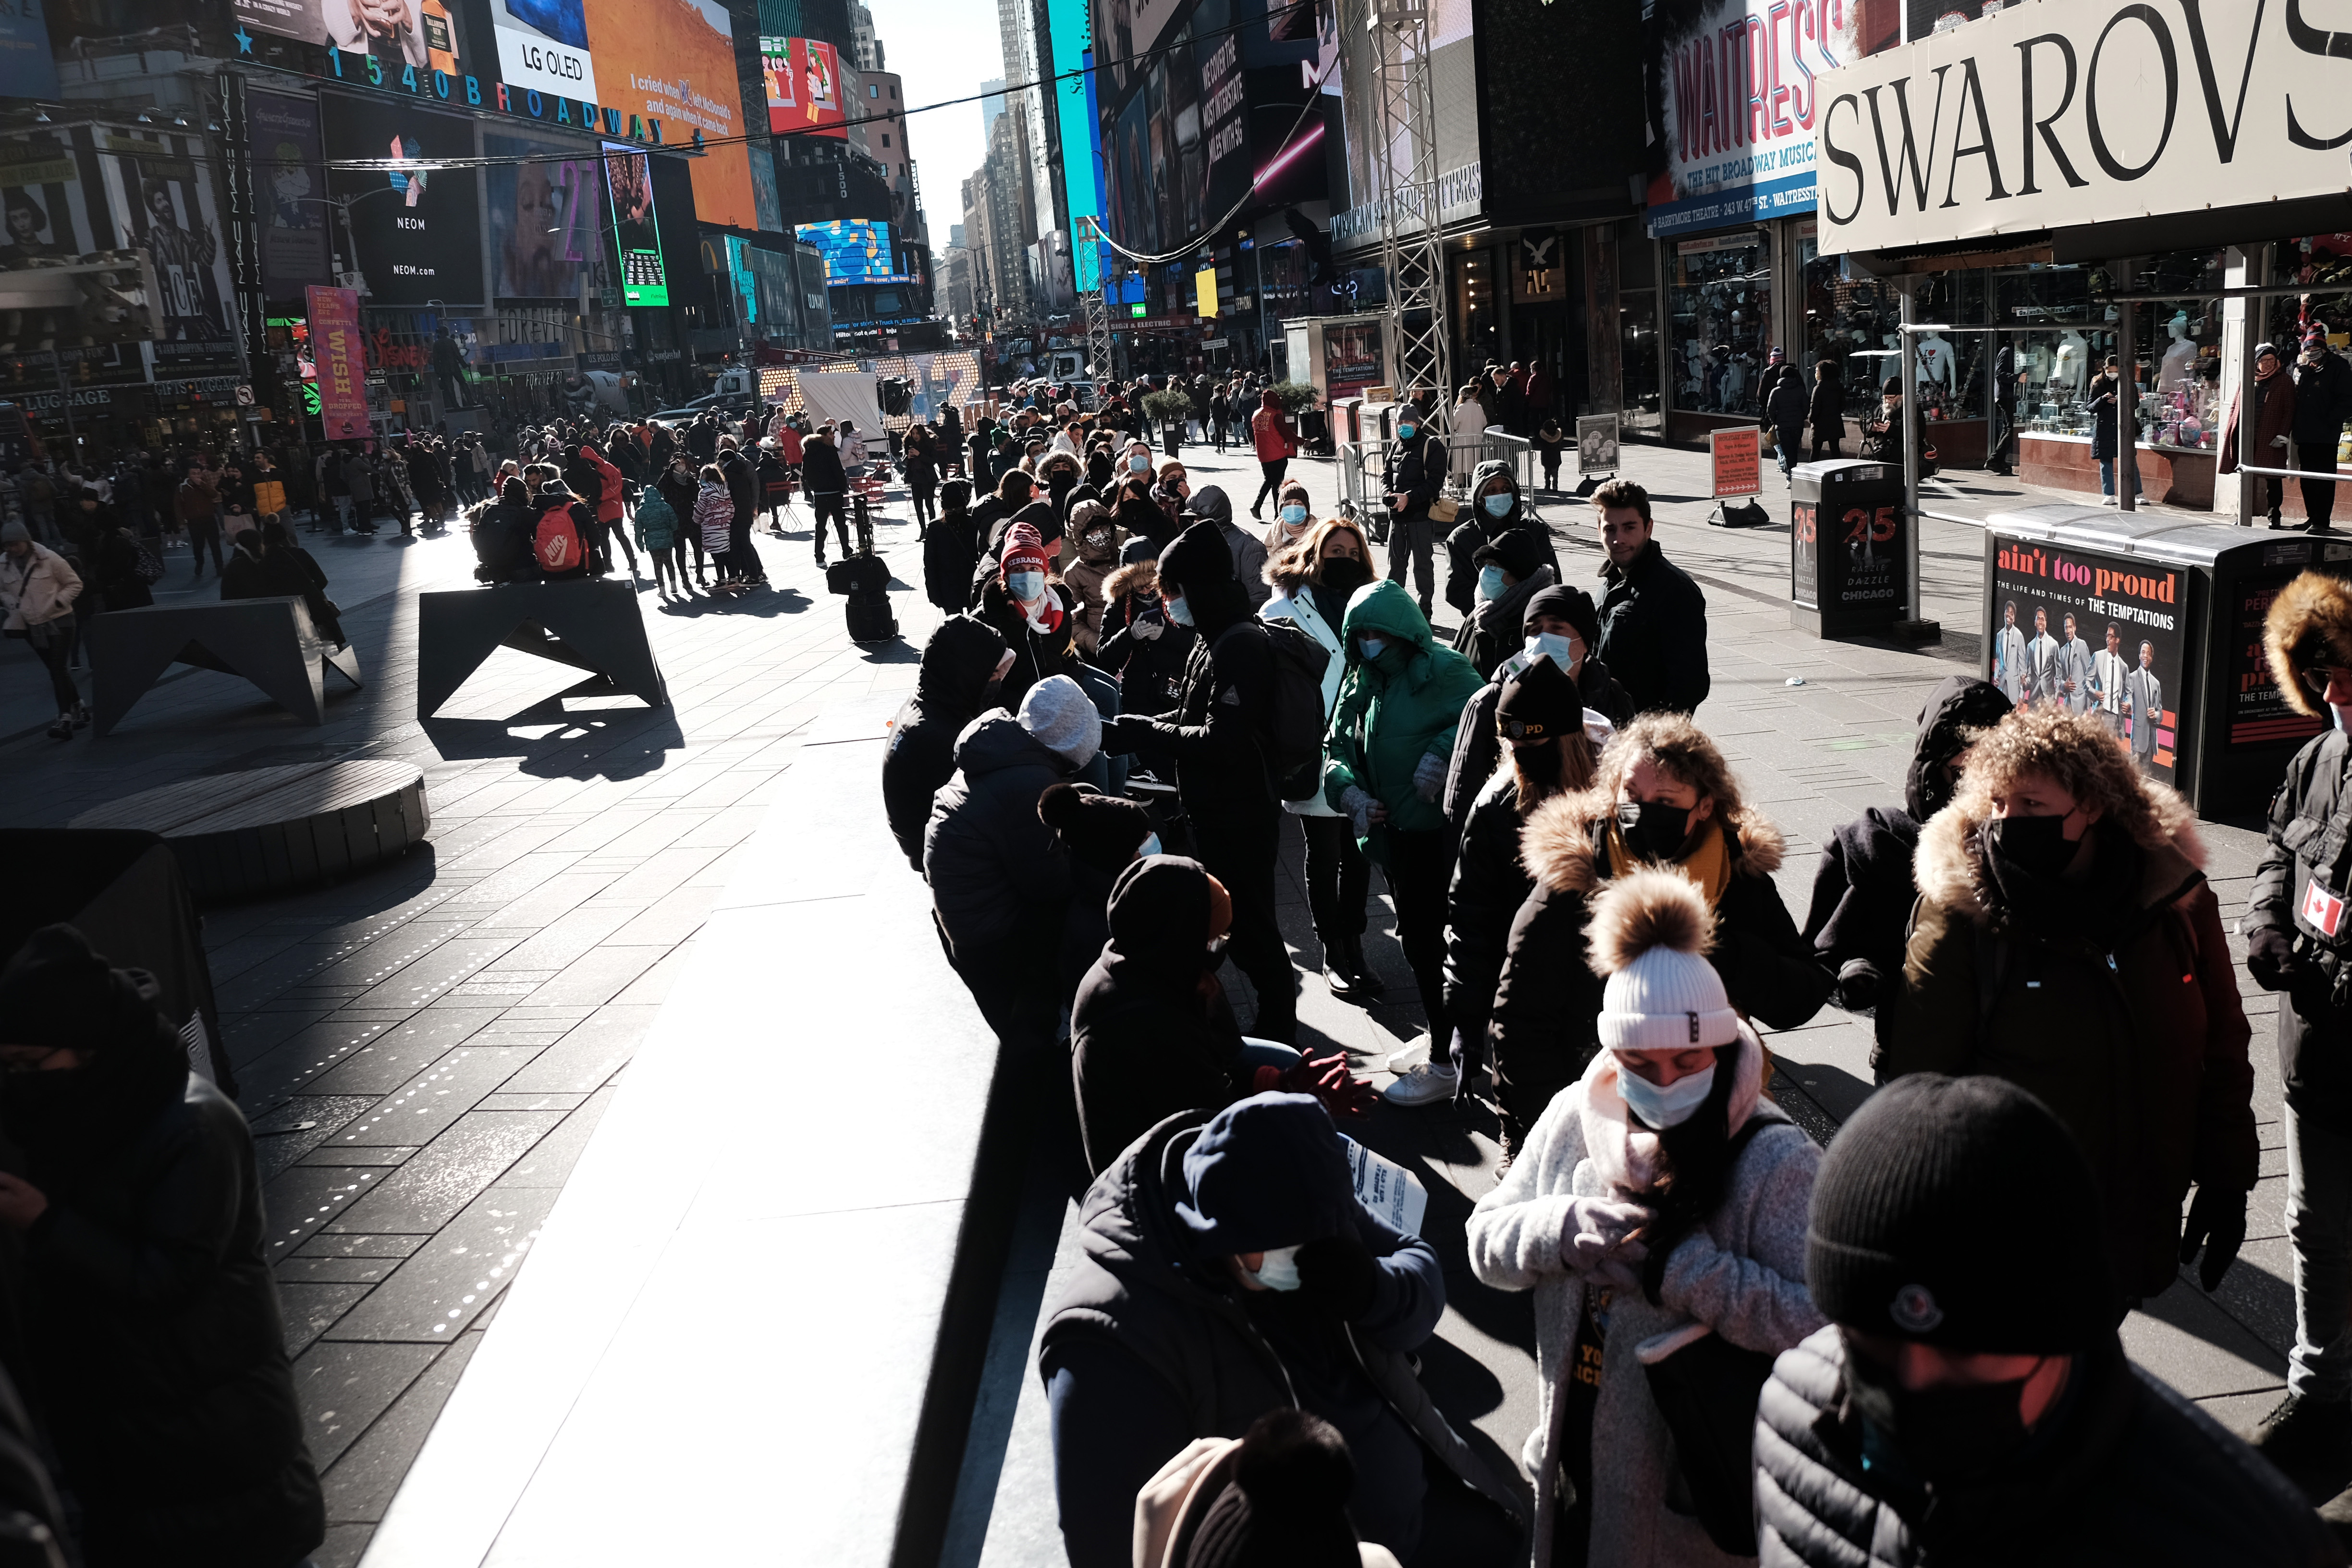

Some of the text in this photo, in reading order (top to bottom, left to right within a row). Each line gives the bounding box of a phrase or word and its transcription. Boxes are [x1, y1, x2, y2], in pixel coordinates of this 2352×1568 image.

[522, 44, 583, 81] LG OLED
[1202, 34, 1236, 91] WE COVER THE
[840, 66, 858, 95] CONNECT
[1672, 0, 1842, 162] WAITRESS
[638, 75, 663, 94] cried
[663, 81, 680, 100] when
[692, 92, 703, 109] left
[703, 97, 731, 120] McDonald's
[1202, 72, 1243, 131] MOST INTERSTATE
[647, 98, 729, 136] and again when it came back
[1208, 116, 1243, 165] MILES WITH 5G
[838, 163, 847, 198] 1500
[1687, 170, 1703, 189] THE
[1705, 165, 1720, 185] HIT
[1723, 152, 1776, 181] BROADWAY
[397, 218, 426, 231] NEOM
[1330, 201, 1372, 242] AMERICAN
[1658, 210, 1691, 229] BARRYMORE
[1692, 205, 1718, 221] THEATRE
[1724, 202, 1735, 215] 243
[393, 265, 435, 276] NEOM.com
[1235, 295, 1252, 311] SEPHORA
[498, 308, 570, 344] FOREVER
[1138, 319, 1171, 328] ELECTRIC
[329, 330, 352, 394] WISH
[597, 354, 609, 363] POLO
[610, 353, 620, 362] ASS
[654, 349, 681, 366] sunglass hut
[1342, 365, 1374, 373] TEMPTATIONS
[154, 382, 187, 396] GIFTS
[526, 372, 554, 387] FOREVER
[1794, 506, 1896, 543] 25 25
[544, 534, 568, 560] NIKE
[1007, 556, 1044, 567] NEBRASKA
[1851, 564, 1885, 573] RAZZLE
[1997, 544, 2175, 604] ain't too proud
[1797, 575, 1814, 585] DAZZLE
[1848, 576, 1889, 586] DAZZLE
[1795, 587, 1816, 600] CHICAGO
[1841, 588, 1894, 601] CHICAGO
[1997, 580, 2174, 630] THE LIFE AND TIMES OF THE TEMPTATIONS
[2239, 692, 2256, 703] THE
[1525, 724, 1543, 734] PD
